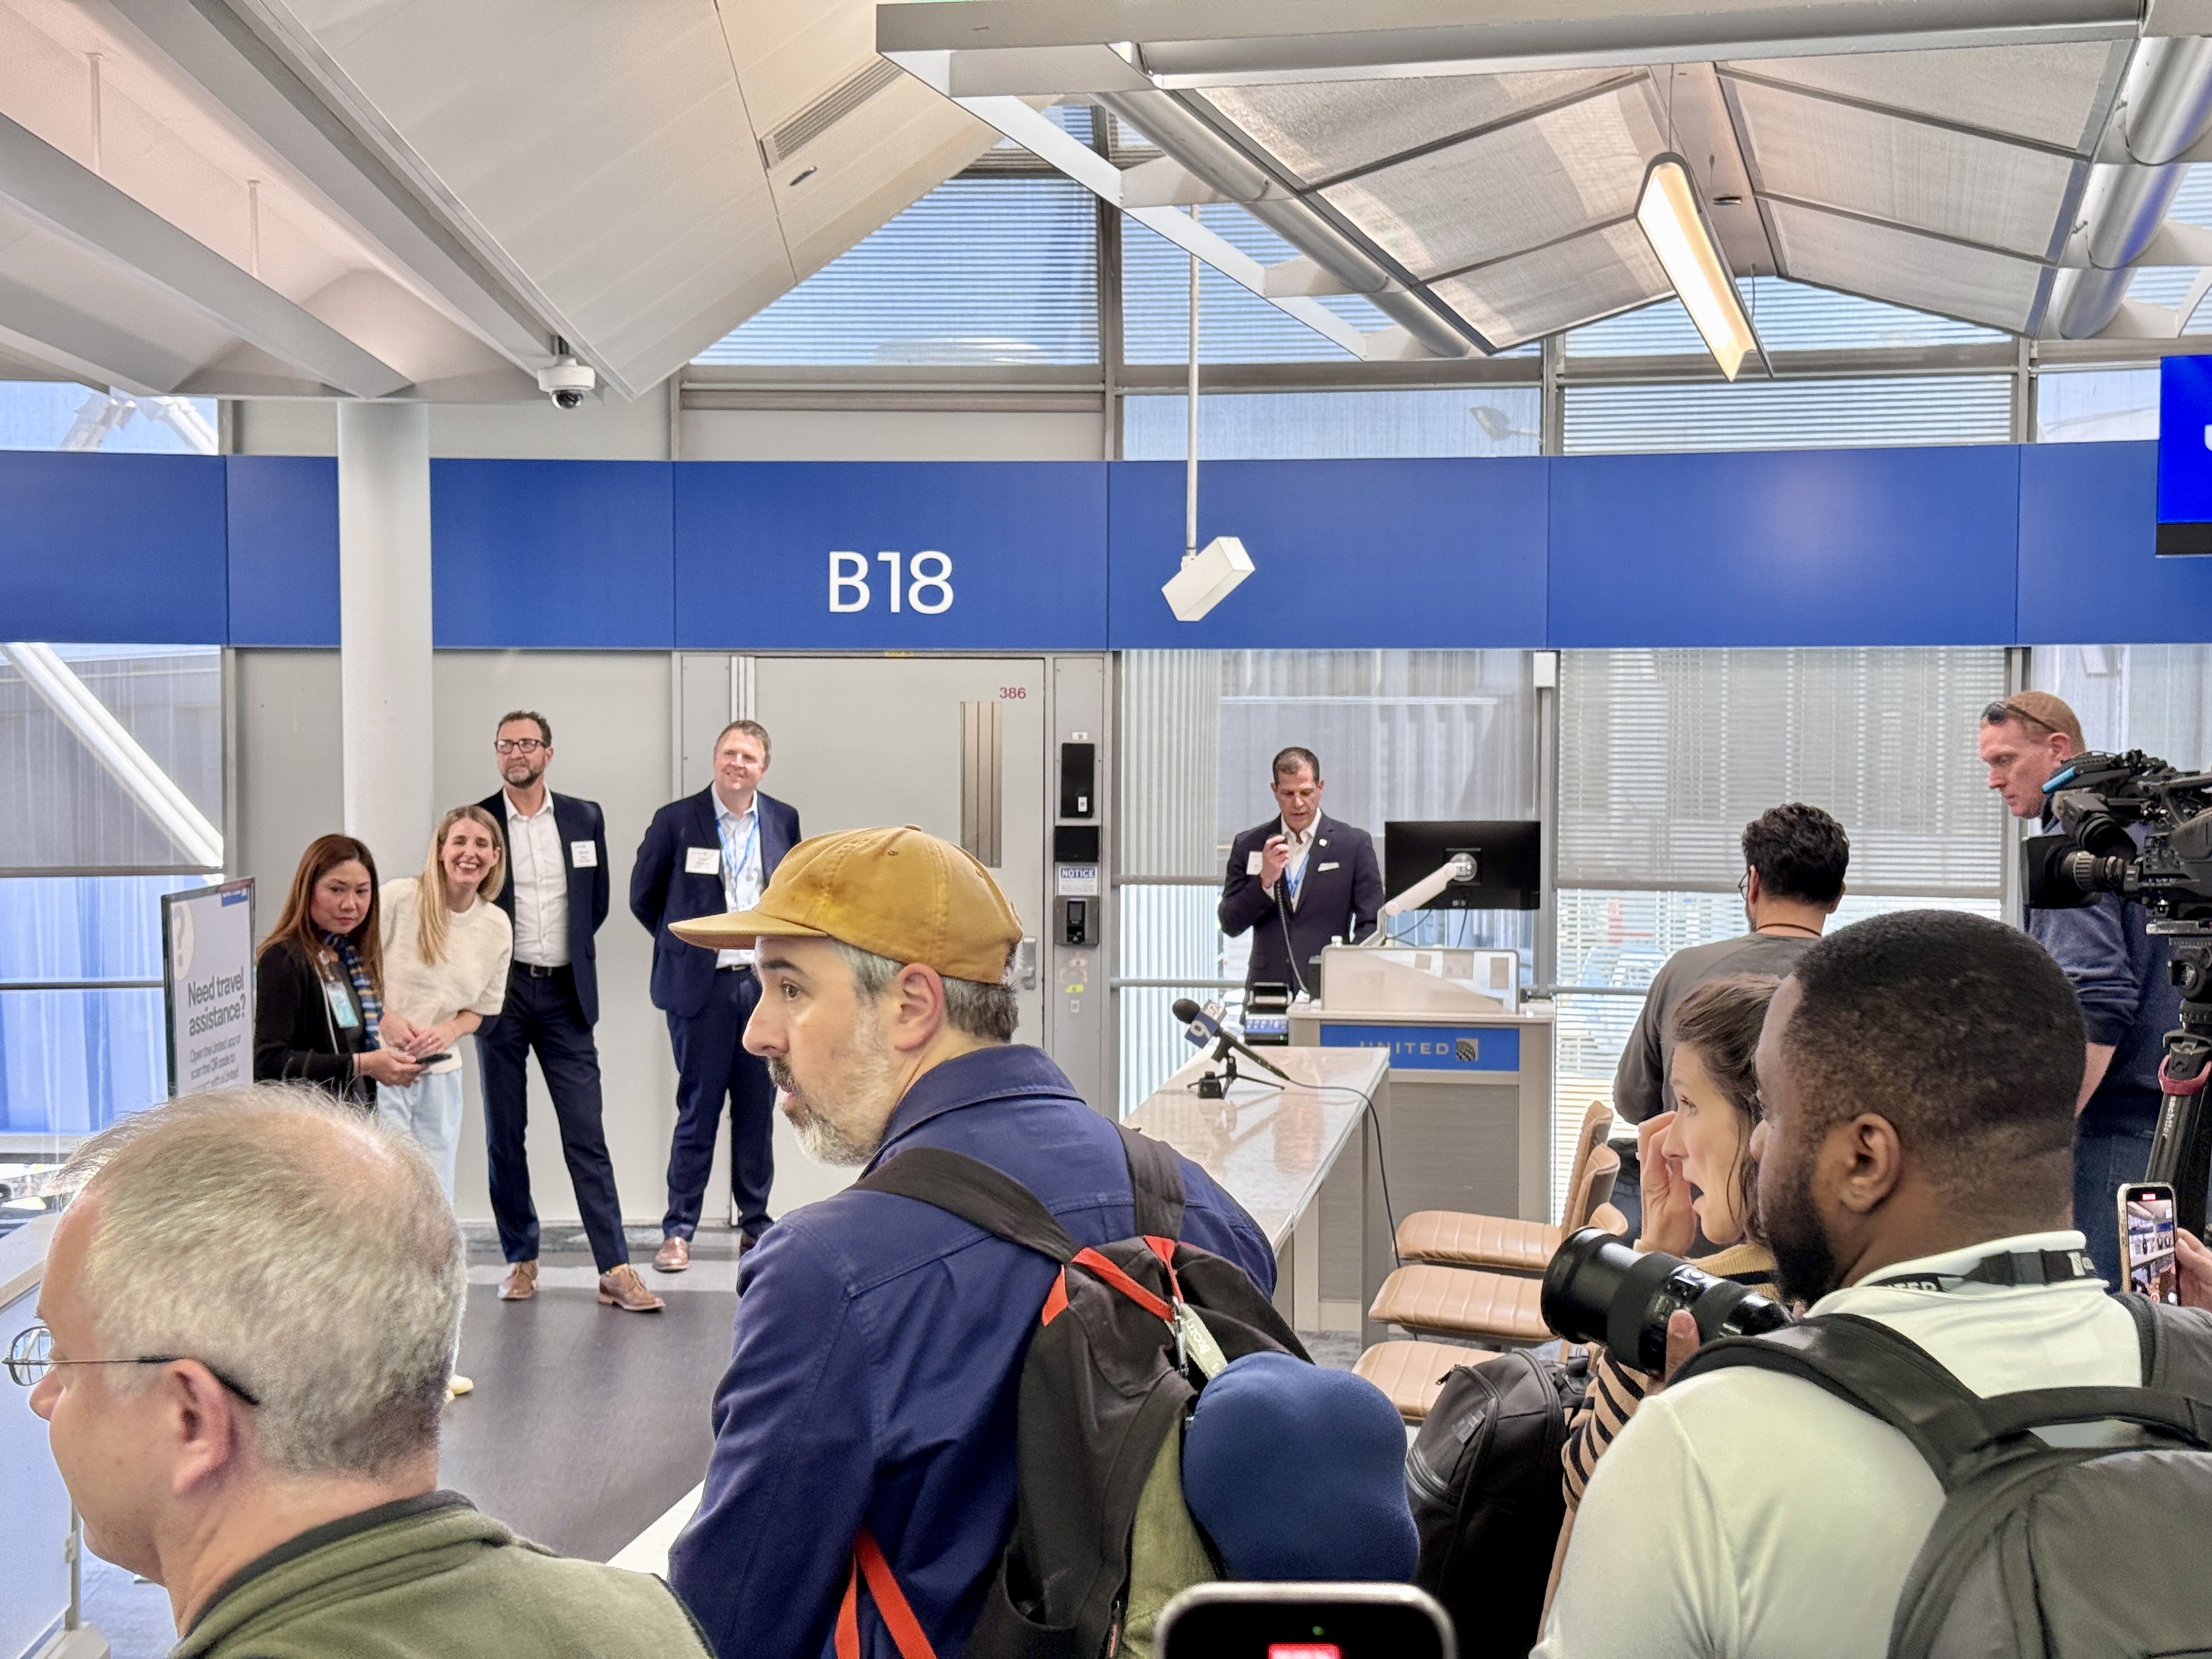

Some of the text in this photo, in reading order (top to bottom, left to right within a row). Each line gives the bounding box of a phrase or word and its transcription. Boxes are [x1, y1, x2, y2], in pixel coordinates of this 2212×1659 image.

[829, 550, 954, 615] B18
[999, 686, 1026, 699] 386
[1062, 869, 1094, 878] NOTICE
[188, 965, 245, 1008] Need travel
[189, 992, 246, 1036] assistance?
[1190, 1020, 1211, 1041] 9
